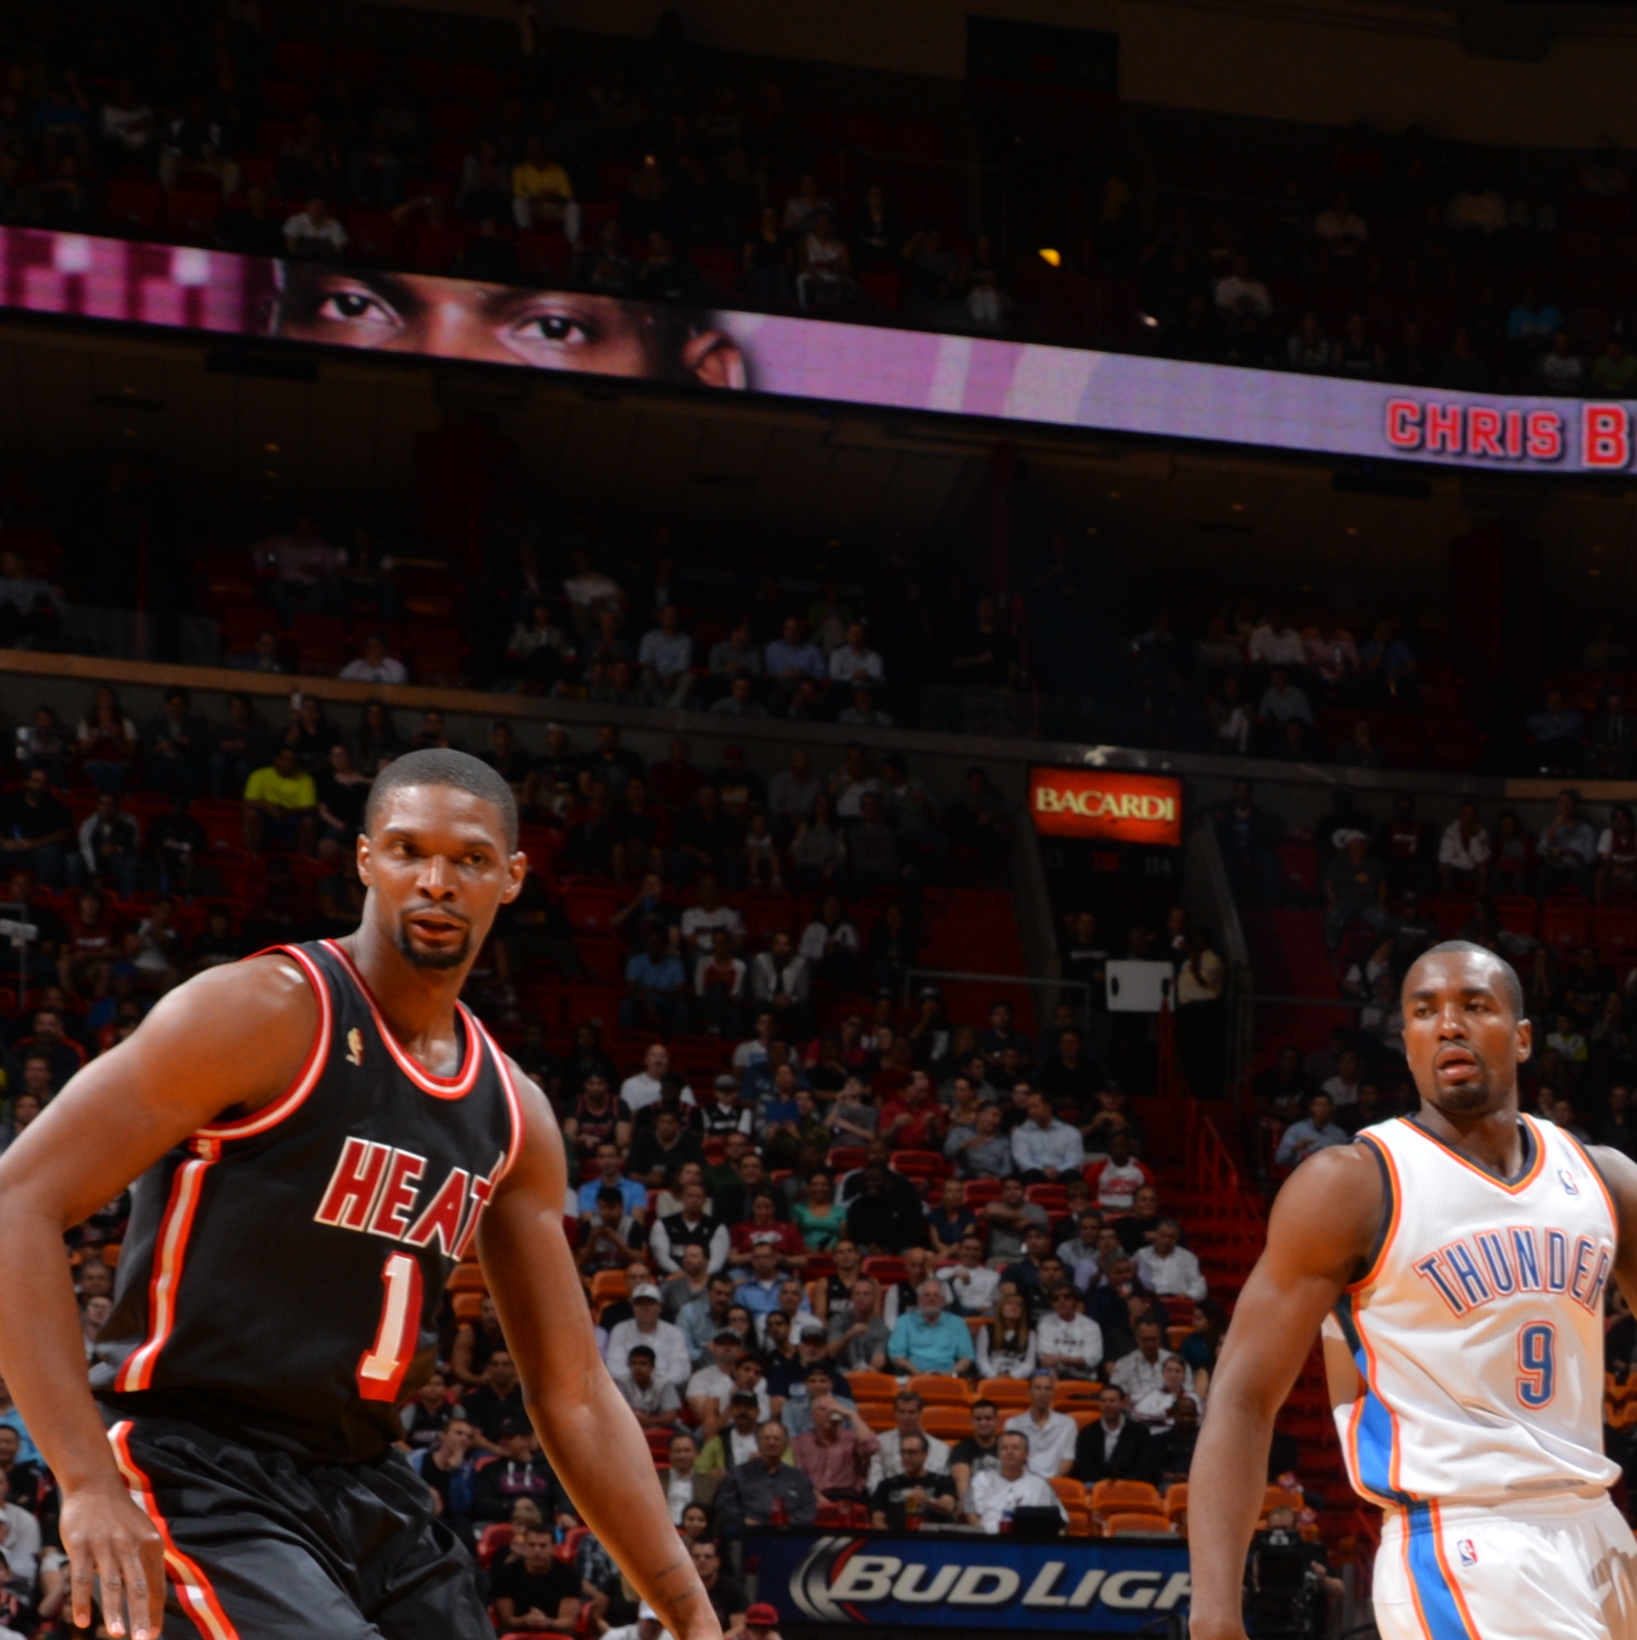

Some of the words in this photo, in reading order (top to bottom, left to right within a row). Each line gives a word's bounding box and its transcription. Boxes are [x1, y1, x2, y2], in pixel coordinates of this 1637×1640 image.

[1386, 399, 1562, 460] CHRIS
[1035, 786, 1175, 822] BACARDI
[313, 1136, 506, 1262] HEAT
[1411, 1226, 1612, 1318] THUNDER
[355, 1250, 424, 1403] 1
[1516, 1319, 1556, 1410] 9
[826, 1553, 1021, 1606] BUD
